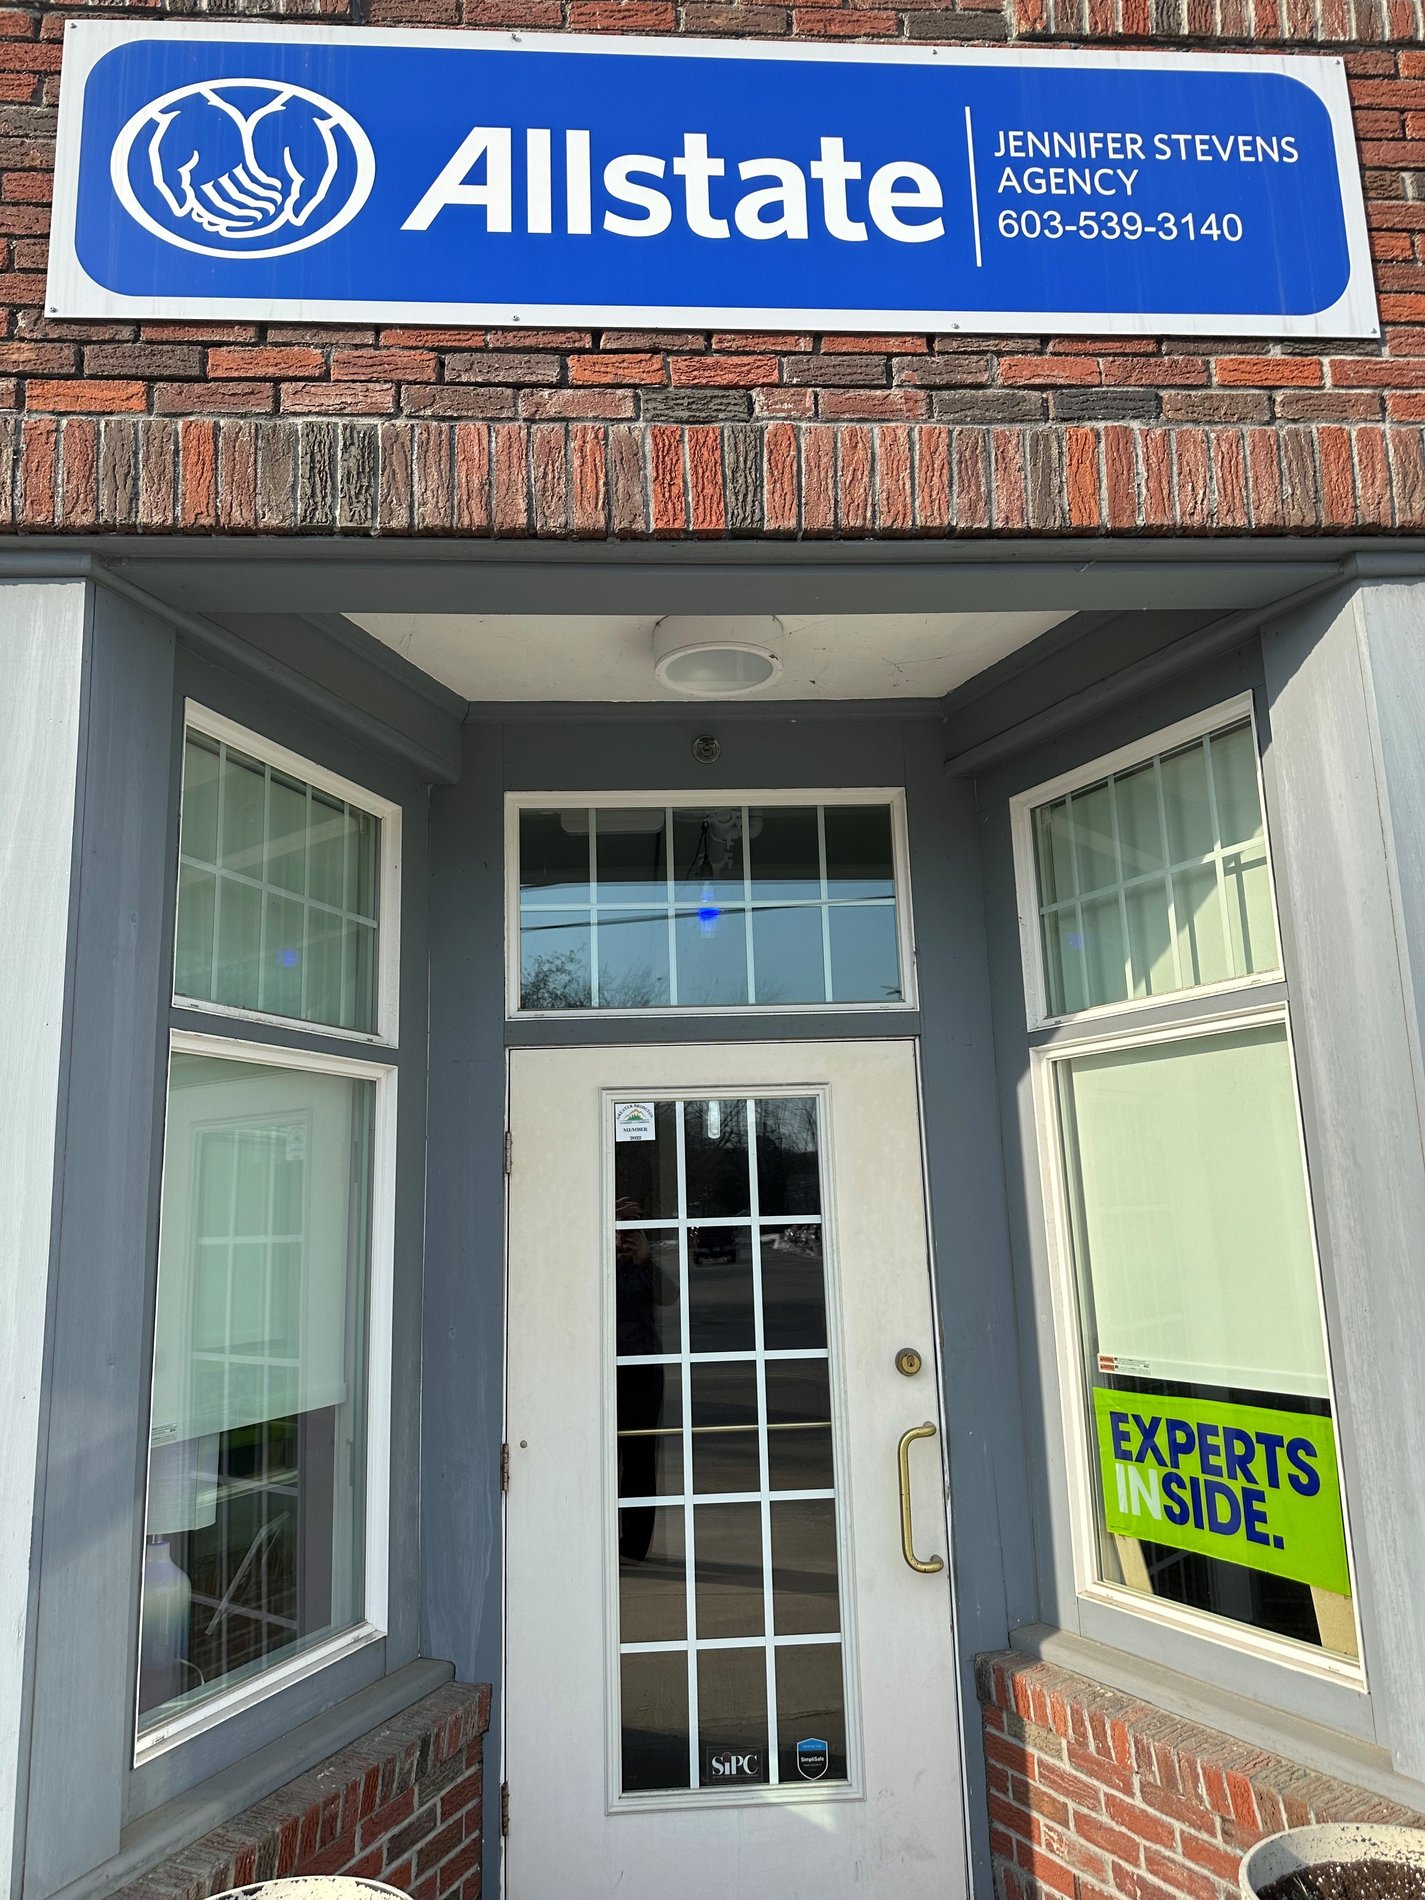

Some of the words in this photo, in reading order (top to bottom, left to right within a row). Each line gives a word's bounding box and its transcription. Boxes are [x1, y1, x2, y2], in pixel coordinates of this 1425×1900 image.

[994, 130, 1146, 160] JENNIFER
[1154, 133, 1299, 163] STEVENS
[400, 126, 945, 243] Allstate
[997, 166, 1139, 196] AGENCY
[998, 209, 1243, 241] 603-539-3140
[1109, 1411, 1320, 1497] EXPERTS
[1115, 1463, 1285, 1550] INSIDE.
